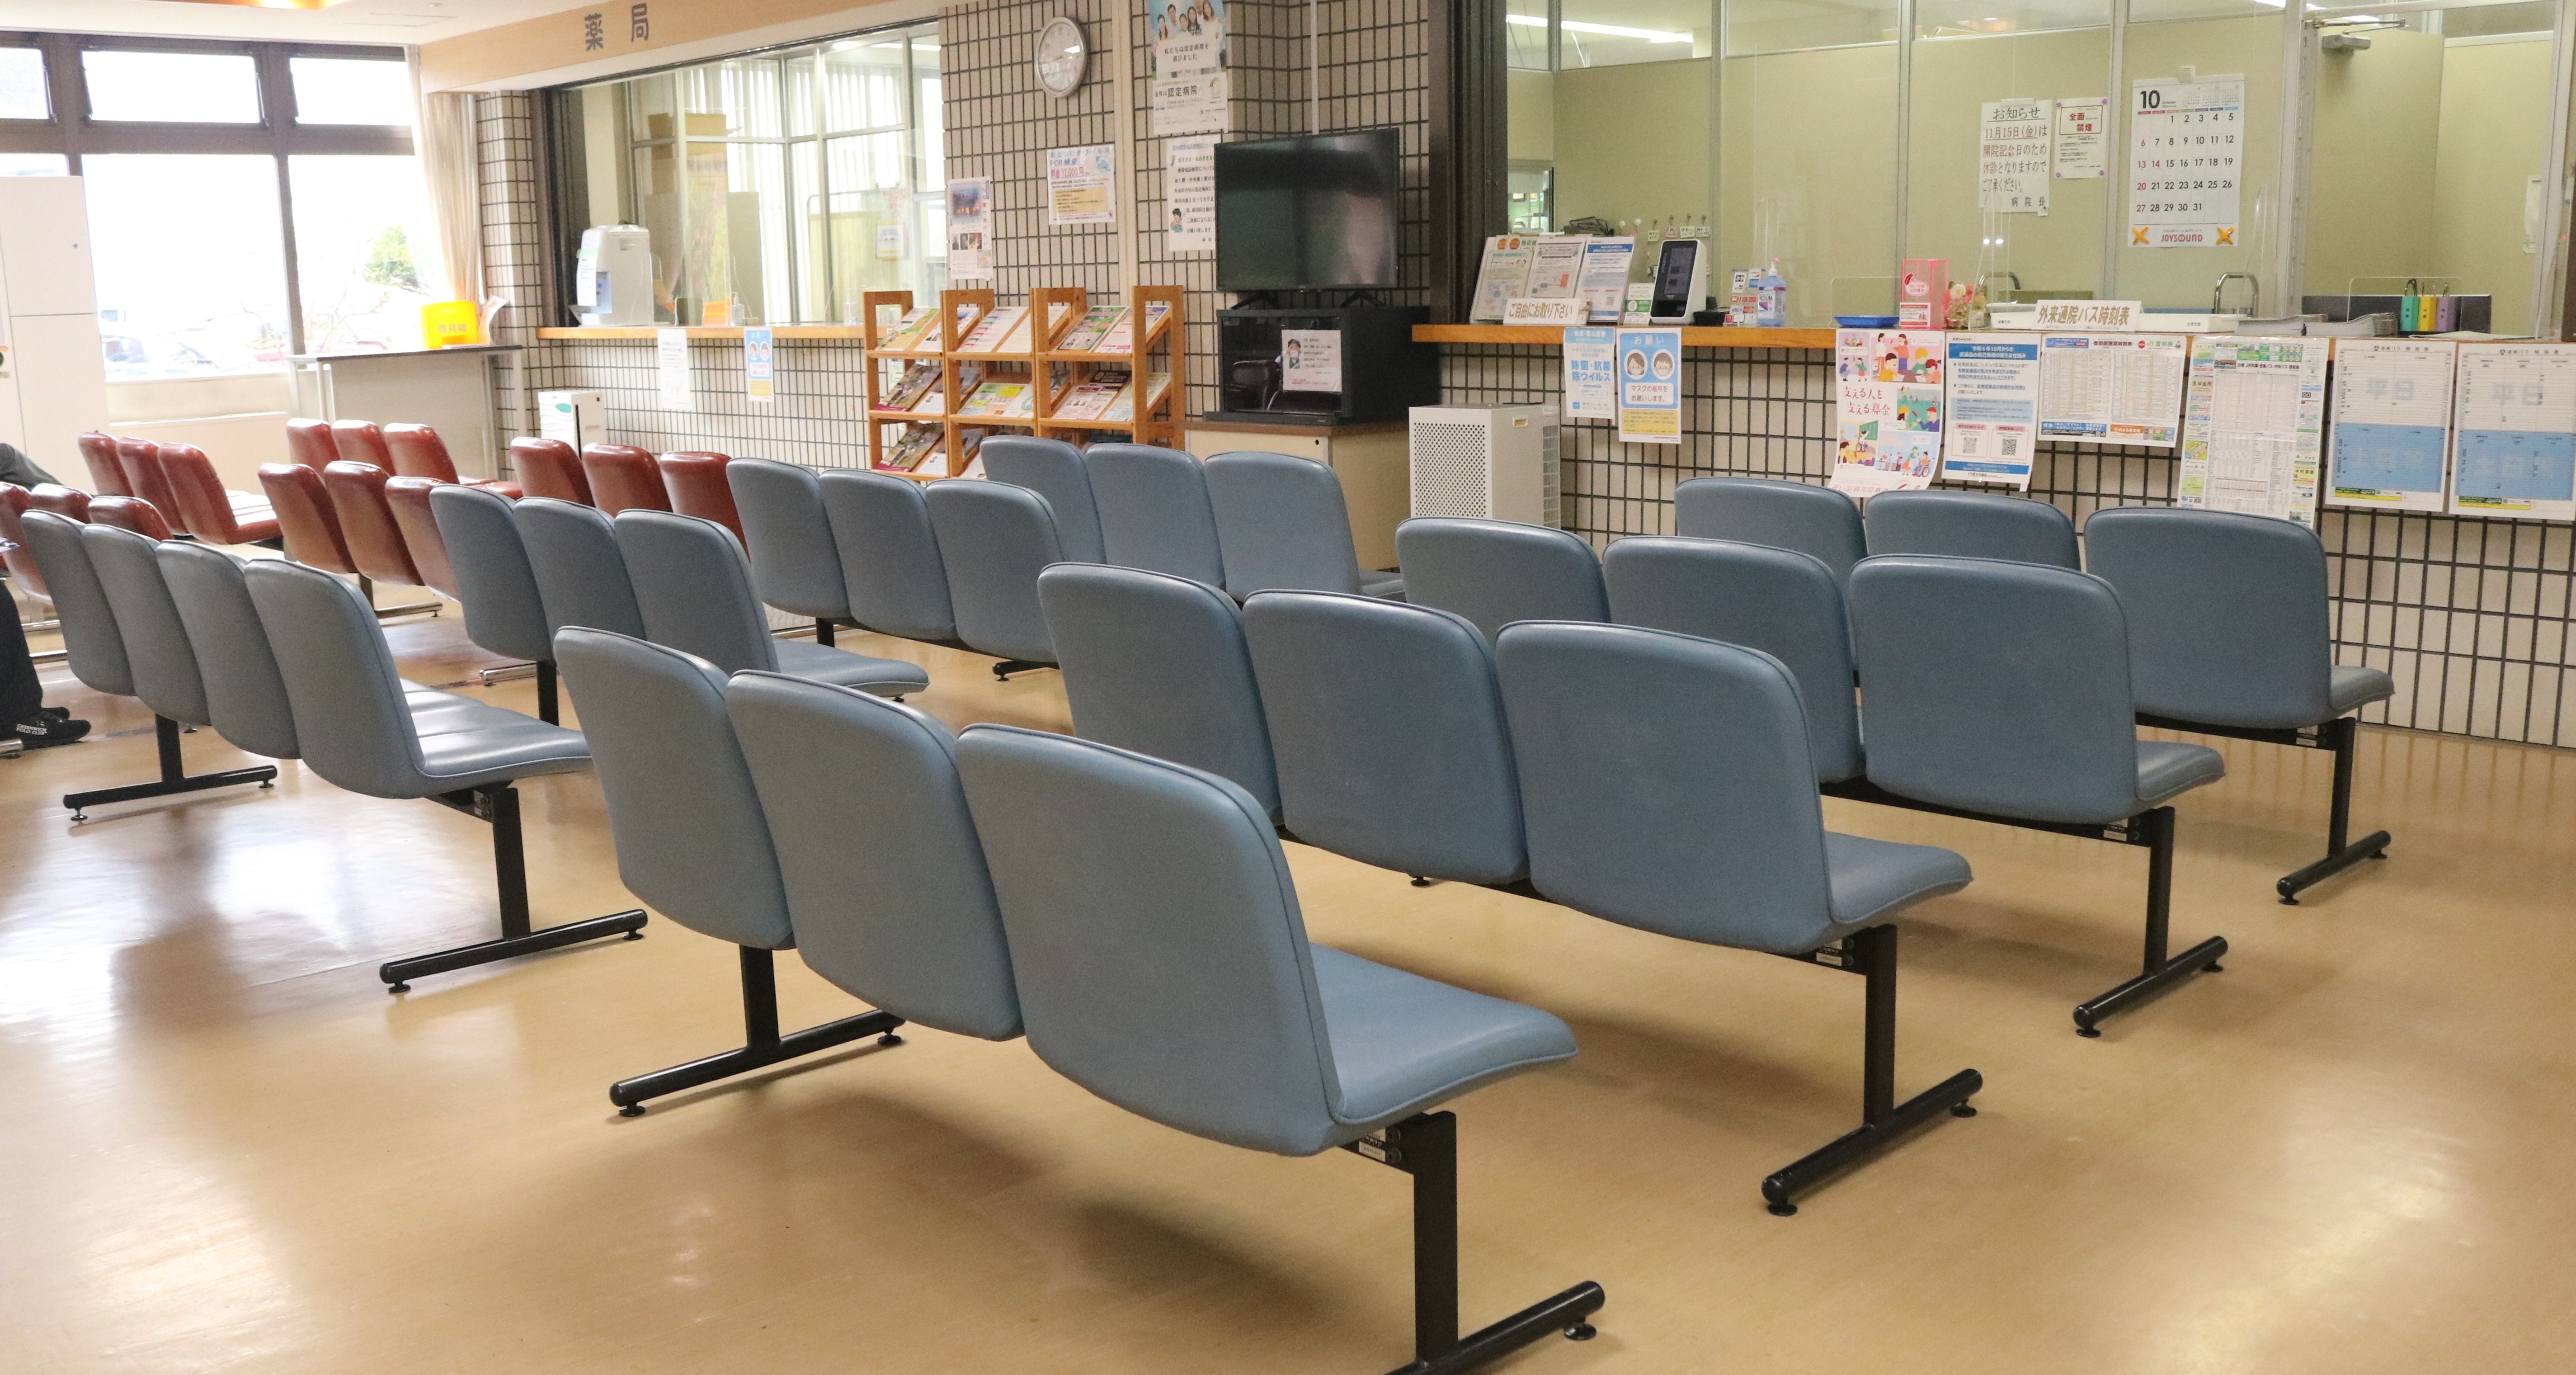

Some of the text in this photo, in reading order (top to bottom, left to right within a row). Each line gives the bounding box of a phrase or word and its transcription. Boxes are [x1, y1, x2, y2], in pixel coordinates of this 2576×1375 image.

[584, 2, 649, 51] 薬局
[1164, 43, 1209, 54] 私たちは認定病院を
[2140, 90, 2160, 109] 10
[1993, 107, 2040, 119] お知らせ
[2069, 113, 2085, 121] 全面
[2077, 123, 2092, 132] 禁煙
[1983, 143, 2047, 157] 開院記念日のため
[1983, 161, 2046, 175] 休診となりますので
[1983, 178, 2022, 193] ご了承ください。
[2011, 196, 2045, 207] 病院長
[2162, 234, 2203, 242] JOYSOUND
[1509, 302, 1573, 318] ご自由にお取り下さい
[2037, 305, 2130, 326] 外来通院バス時刻表
[1634, 335, 1664, 345] お願い
[1572, 360, 1611, 371] 除菌・抗菌
[1572, 371, 1611, 382] 除ウイルス
[1843, 386, 1883, 400] 支える人を
[1847, 403, 1891, 416] 支える募金
